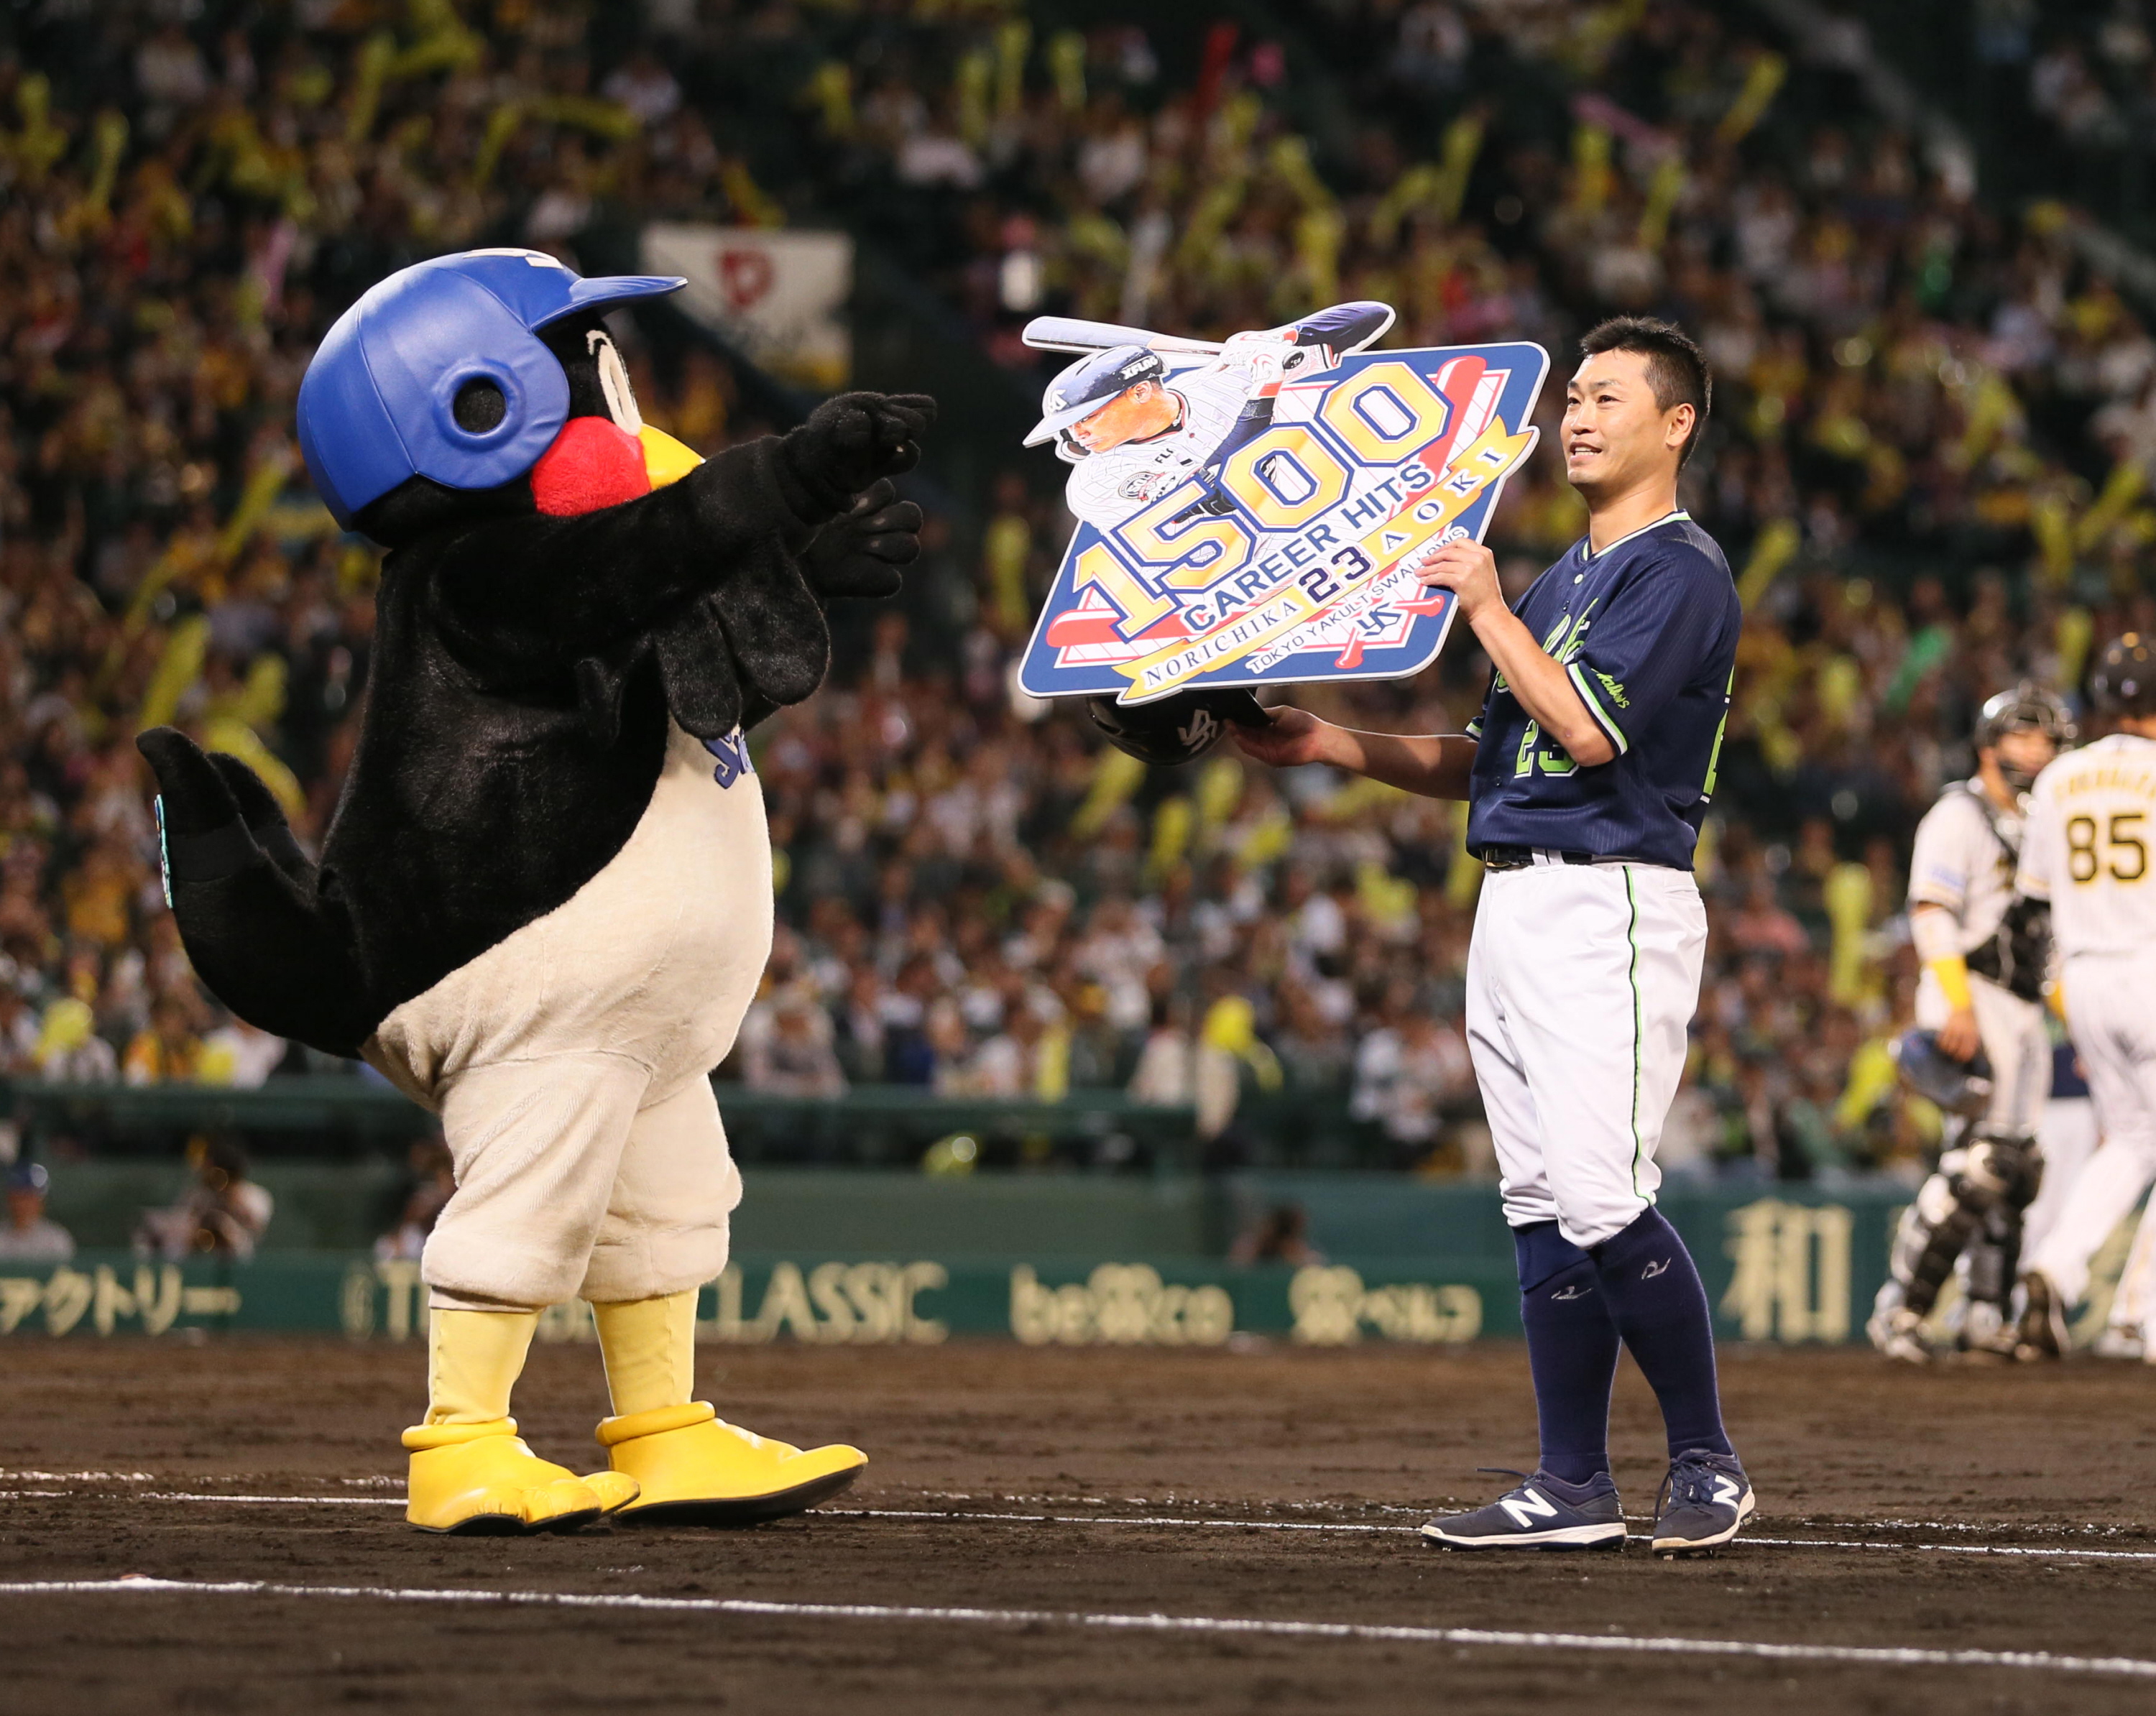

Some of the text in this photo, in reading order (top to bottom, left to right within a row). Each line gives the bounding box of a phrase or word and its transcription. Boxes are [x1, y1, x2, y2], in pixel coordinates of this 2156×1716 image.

[1070, 360, 1455, 645] 1500
[1145, 450, 1503, 686] NORICHIKA 23 AOKI
[1184, 463, 1432, 631] CAREER HITS
[1250, 635, 1304, 672] TOKYO
[1306, 594, 1370, 637] YAKULT
[2065, 813, 2146, 883] 85
